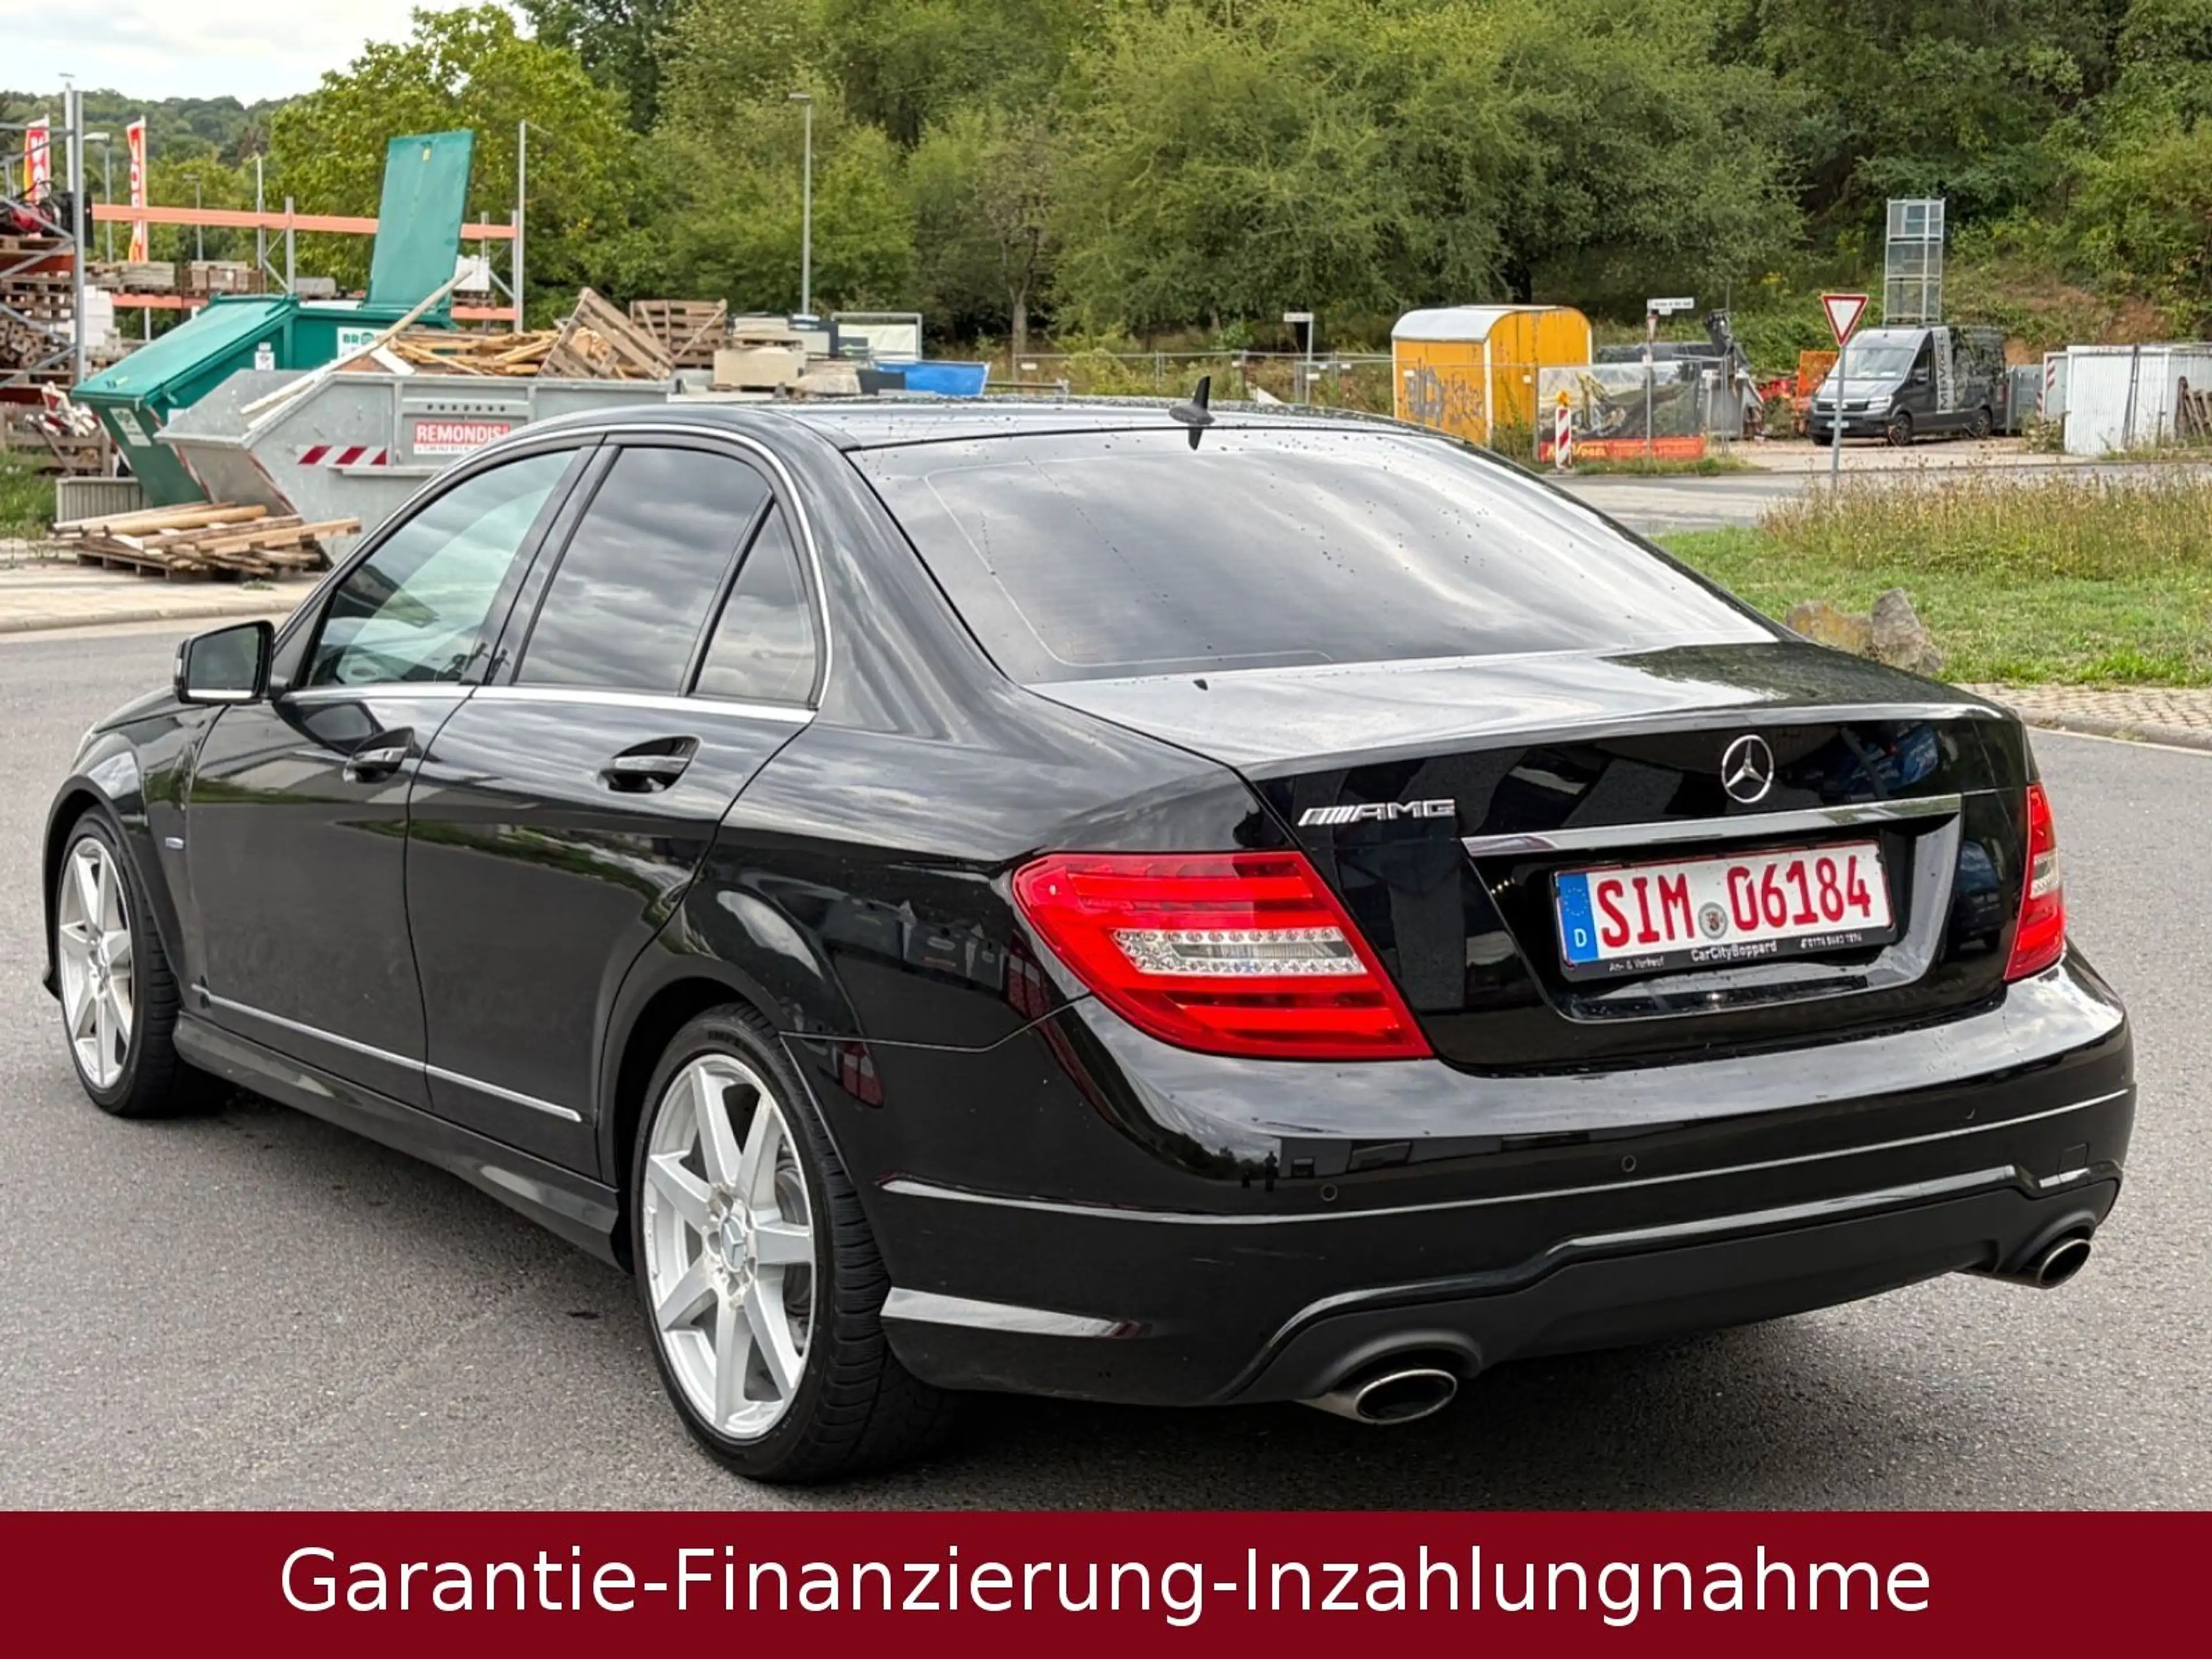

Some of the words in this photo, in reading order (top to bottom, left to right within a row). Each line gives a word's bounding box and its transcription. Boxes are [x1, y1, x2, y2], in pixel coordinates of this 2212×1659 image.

[1350, 798, 1456, 822] AMG
[1597, 872, 1695, 949] SIM
[1726, 854, 1871, 933] 06184
[1573, 928, 1587, 948] D
